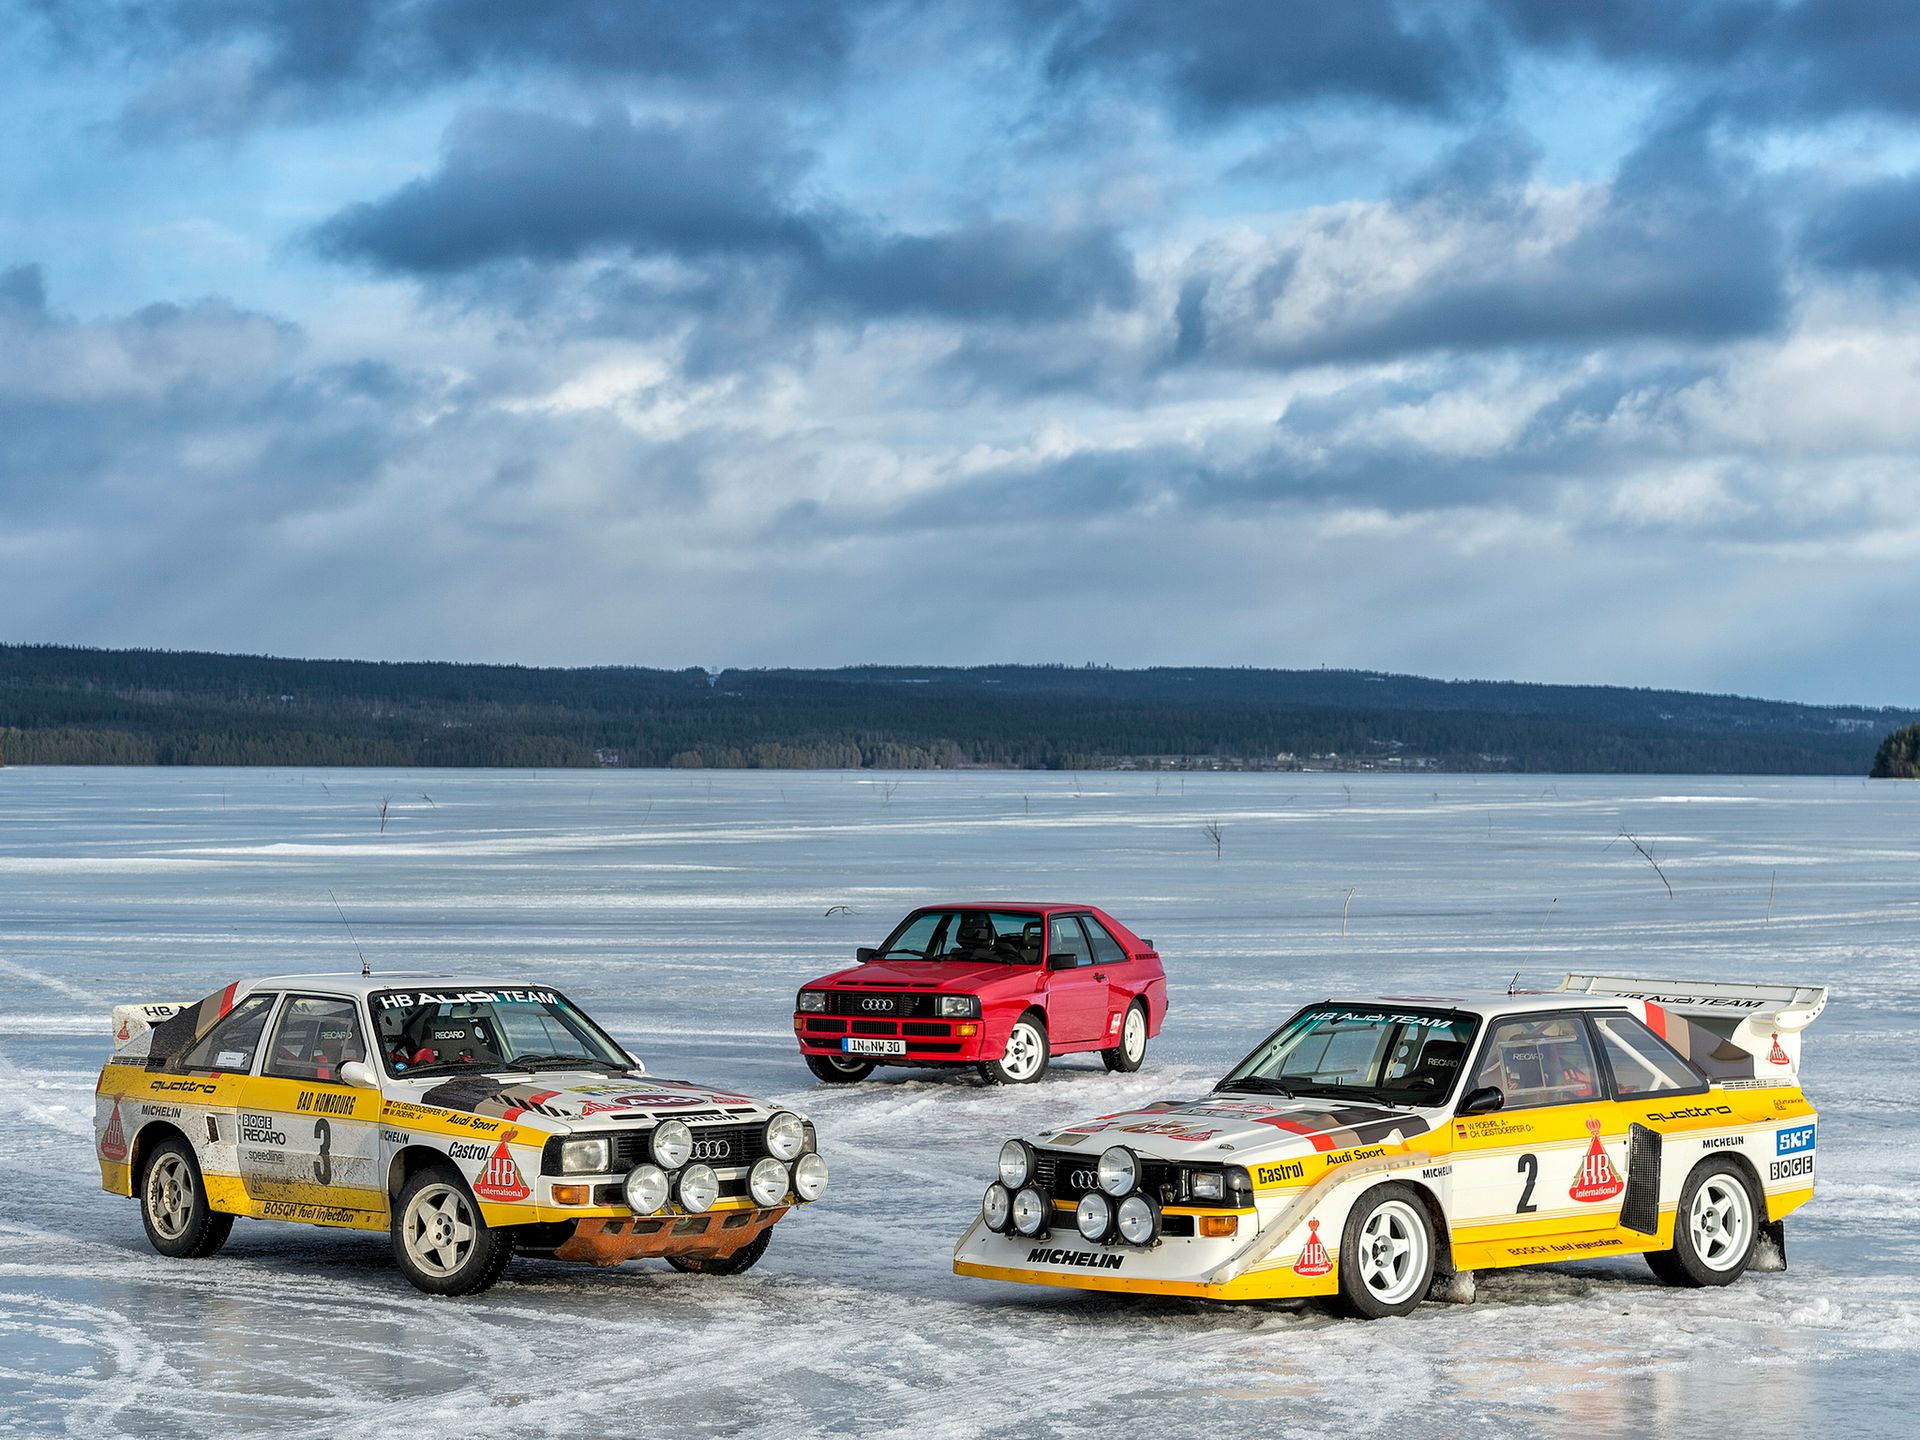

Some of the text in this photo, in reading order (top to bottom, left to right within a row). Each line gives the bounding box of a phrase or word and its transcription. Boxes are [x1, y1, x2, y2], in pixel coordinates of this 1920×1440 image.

[380, 993, 414, 1009] HB
[498, 990, 559, 1005] TEAM
[1698, 998, 1766, 1008] TEAM
[144, 1006, 173, 1016] HB
[1306, 1012, 1337, 1021] HB
[1388, 1014, 1454, 1028] TEAM
[321, 1031, 353, 1039] RECARO
[434, 1030, 465, 1040] RECARO
[852, 1040, 900, 1053] IN NW 30
[1428, 1057, 1459, 1068] RECARO
[1513, 1053, 1545, 1061] RECARO
[150, 1081, 216, 1094] quattro
[297, 1091, 356, 1115] BAD HOMBOURG
[141, 1105, 182, 1118] MICHELIN
[1646, 1106, 1732, 1122] quattro
[243, 1114, 272, 1129] BOGE
[446, 1114, 499, 1132] Audi Sport
[243, 1129, 286, 1145] RECARO
[1702, 1136, 1745, 1149] MICHELIN
[1779, 1129, 1814, 1151] SKF
[313, 1118, 331, 1185] 3
[448, 1141, 490, 1161] Castrol
[1326, 1147, 1387, 1166] Audi Sport
[487, 1157, 517, 1187] HB
[1258, 1161, 1305, 1185] Castrol
[1582, 1153, 1611, 1186] HB
[1770, 1155, 1813, 1181] BOGE
[481, 1185, 524, 1198] international
[1516, 1153, 1538, 1214] 2
[1575, 1184, 1618, 1198] international
[263, 1202, 354, 1223] BOSCH fuel injection
[1304, 1243, 1325, 1265] HB
[1508, 1239, 1623, 1256] BOSCH fuel injection
[1027, 1249, 1124, 1269] MICHELIN
